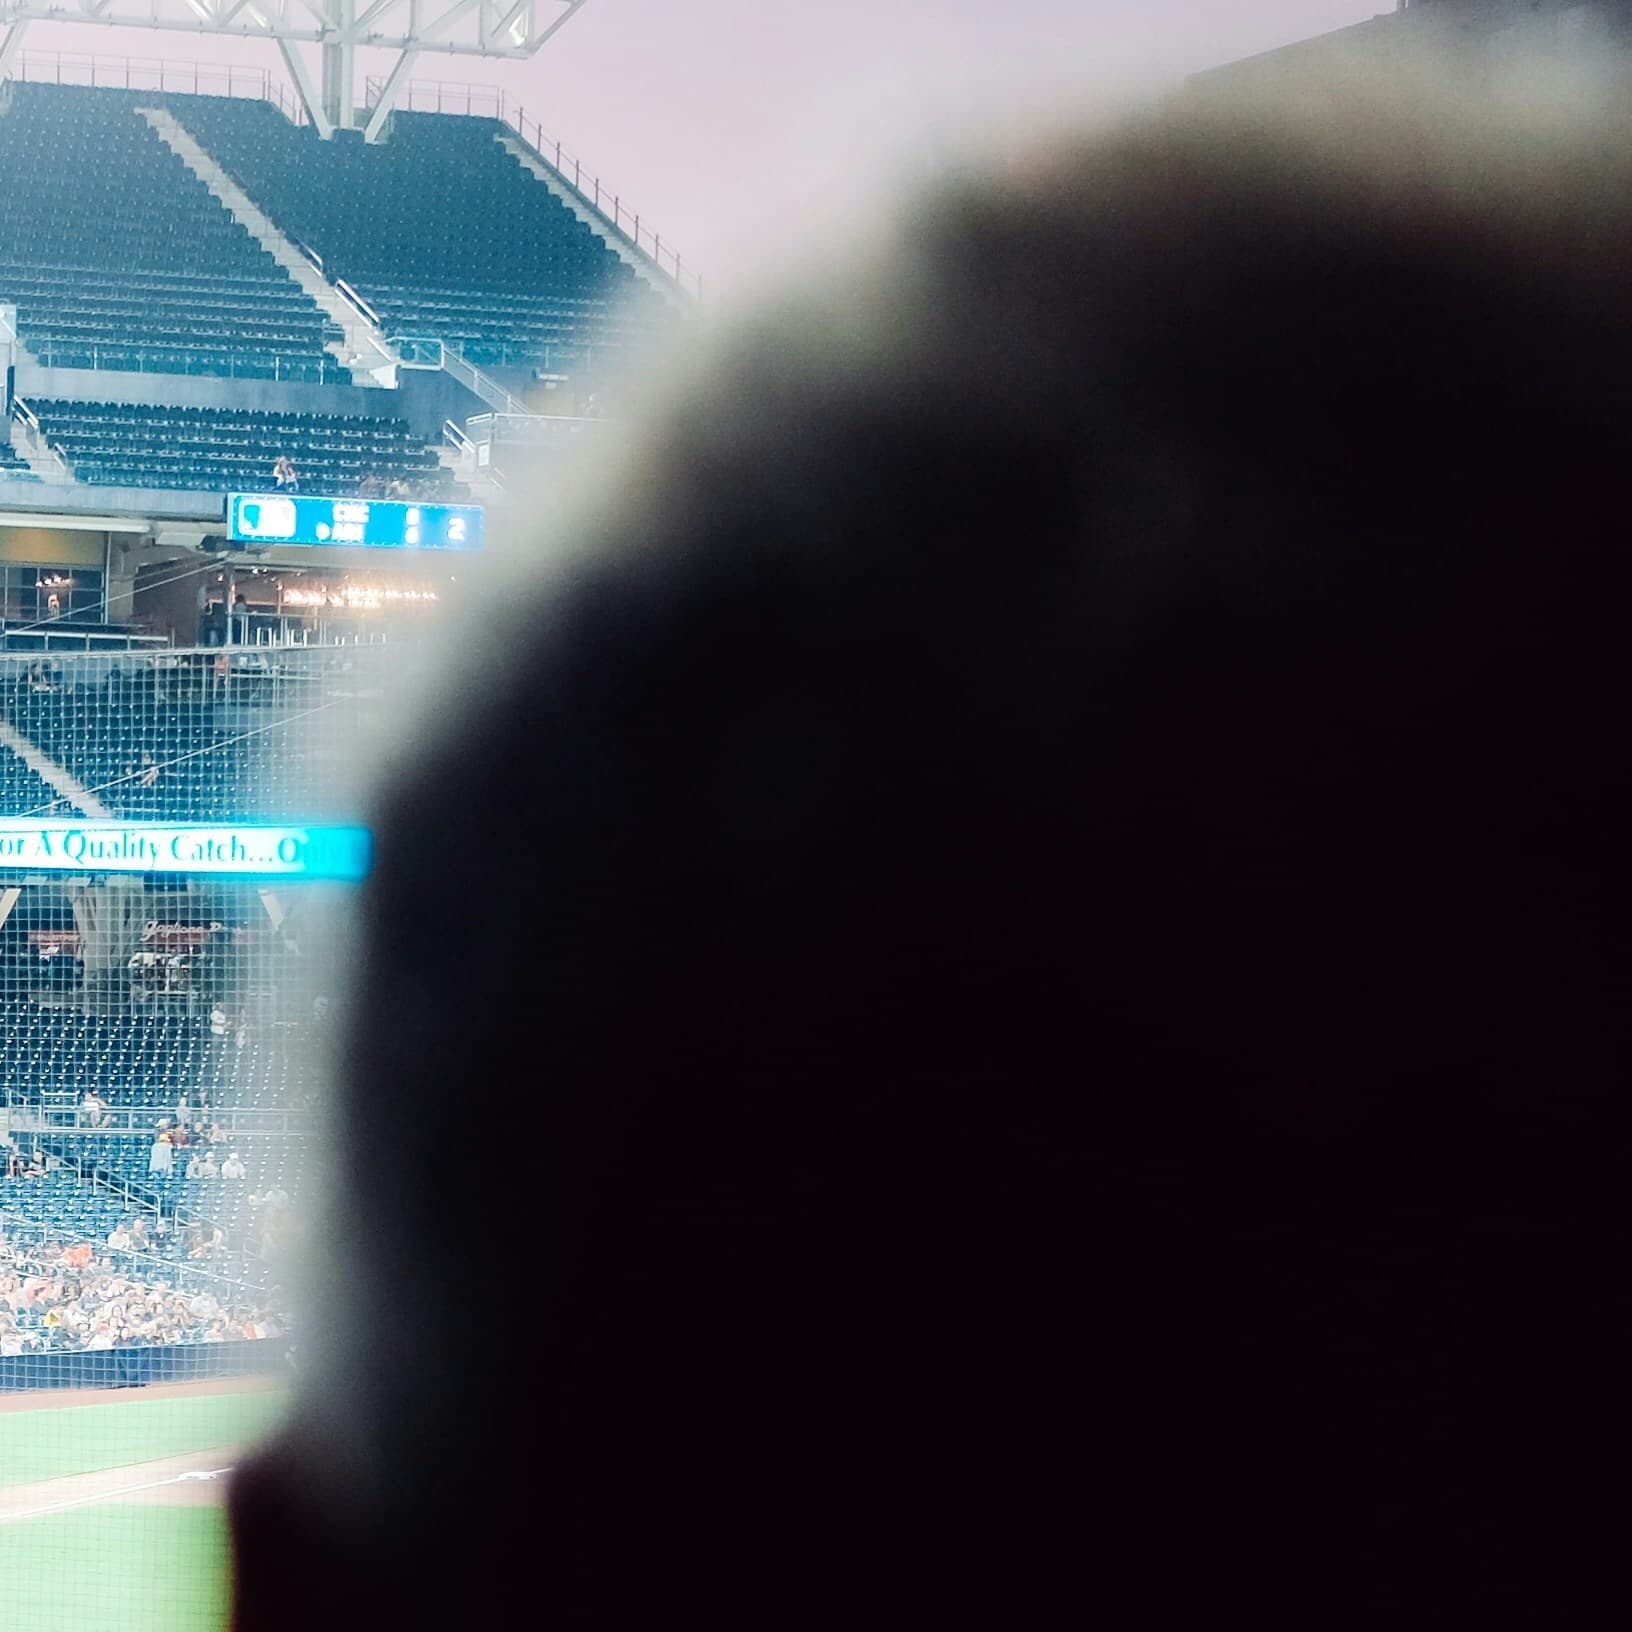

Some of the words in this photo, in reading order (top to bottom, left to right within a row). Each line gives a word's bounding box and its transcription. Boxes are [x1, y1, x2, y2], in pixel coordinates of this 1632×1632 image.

[447, 517, 465, 541] 2
[34, 830, 53, 857] A
[63, 829, 161, 868] Quality
